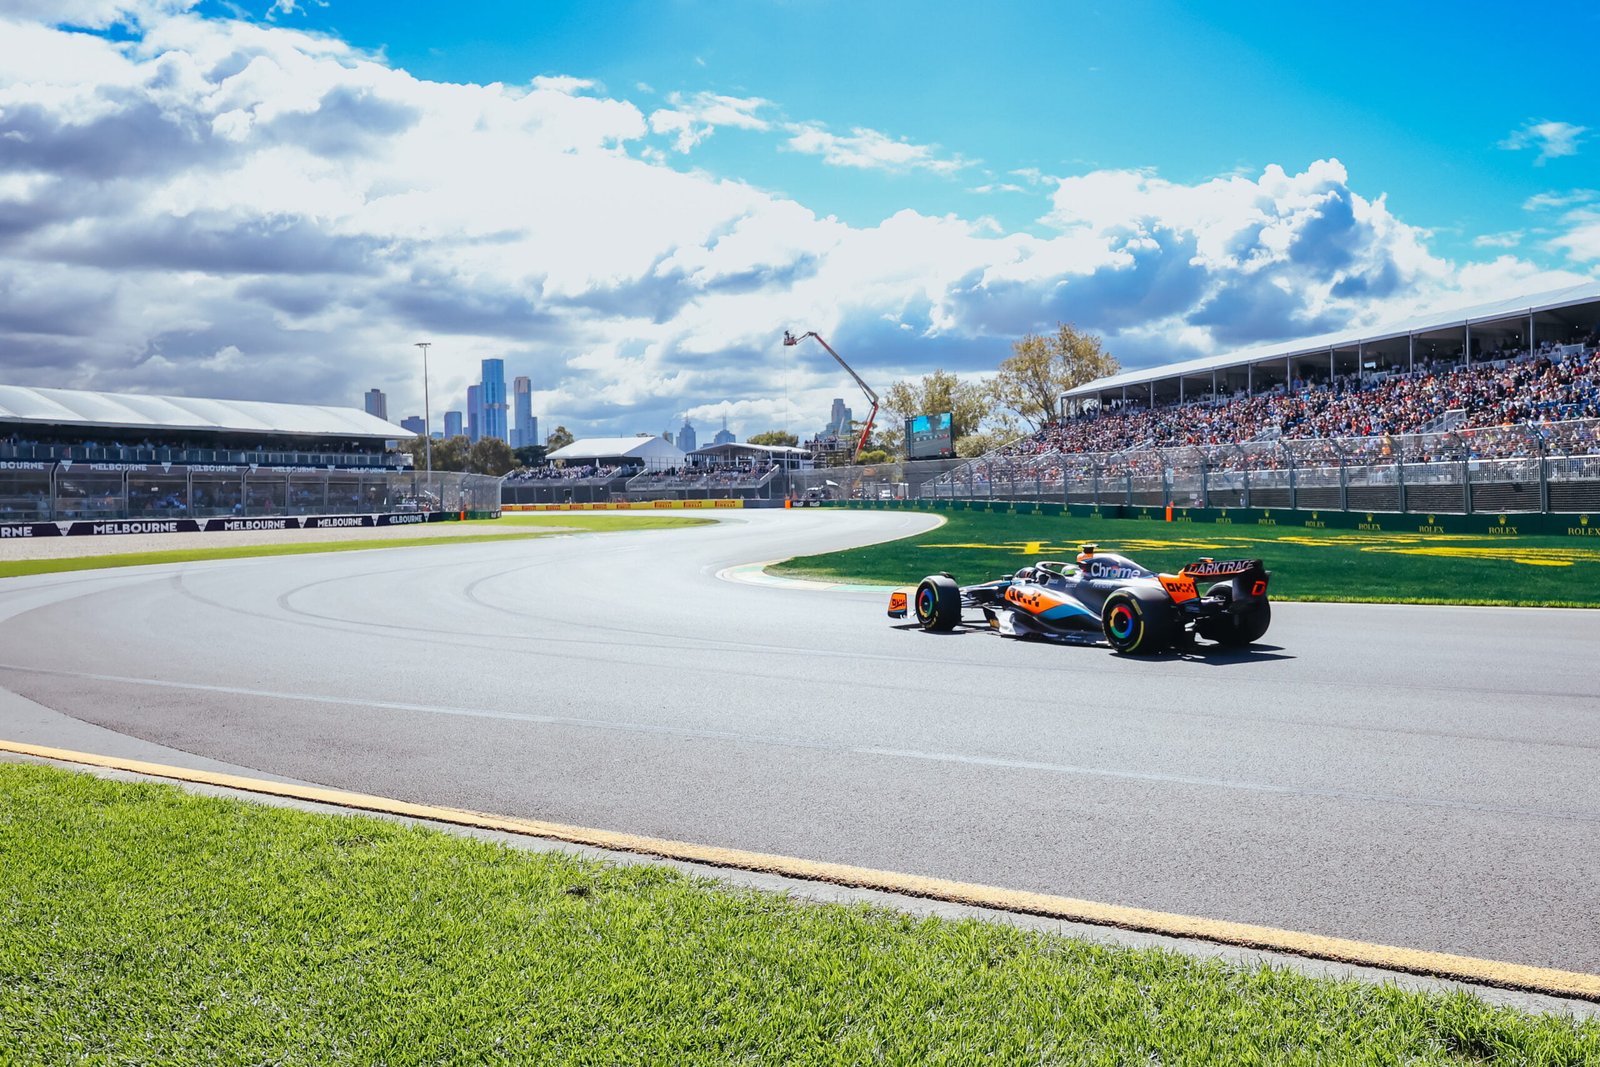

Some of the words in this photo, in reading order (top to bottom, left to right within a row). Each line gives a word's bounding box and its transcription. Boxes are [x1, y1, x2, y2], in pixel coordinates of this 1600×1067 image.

[0, 461, 44, 470] BOURNE
[90, 463, 148, 471] MELBOURNE
[224, 520, 286, 531] MELBOURNE
[317, 517, 363, 528] MELBOURNE
[1305, 520, 1325, 528] ROLEX
[1358, 523, 1381, 531] ROLEX
[0, 526, 33, 537] RNE
[93, 522, 178, 535] MELBOURNE
[1418, 525, 1444, 533] ROLEX
[1488, 527, 1518, 535] ROLEX
[1568, 527, 1600, 536] ROLEX
[1091, 562, 1140, 578] Chrome
[1189, 560, 1256, 574] DARKTRACE
[1166, 583, 1194, 593] OKX
